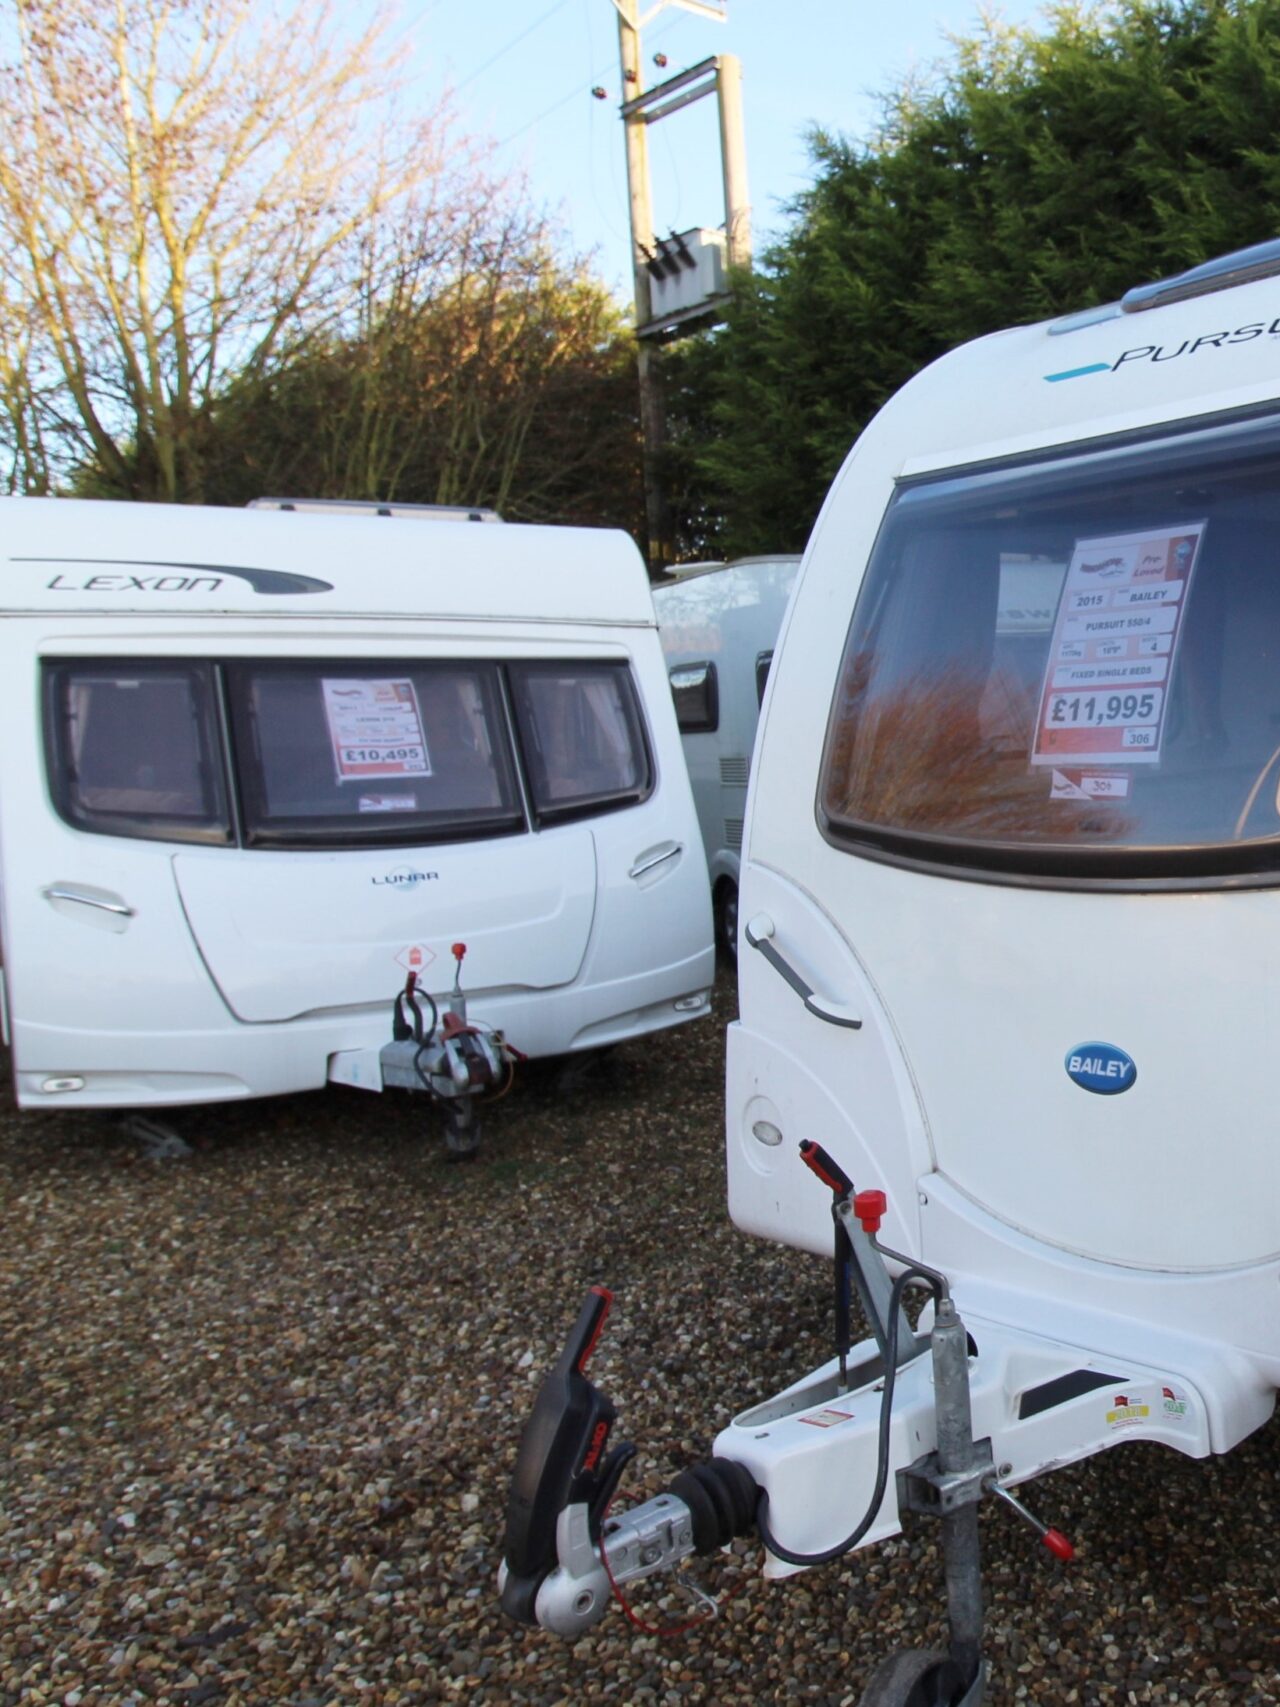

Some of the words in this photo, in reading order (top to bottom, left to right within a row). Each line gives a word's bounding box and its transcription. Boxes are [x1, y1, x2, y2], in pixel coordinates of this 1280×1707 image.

[46, 574, 224, 592] LEXON
[1077, 595, 1103, 606] 2015
[1129, 589, 1167, 602] BAILEY
[1086, 619, 1125, 631] PURSUIT
[1070, 670, 1095, 679] FIXED
[1096, 667, 1128, 678] SINGLE
[1129, 665, 1152, 675] BEDS
[1051, 694, 1154, 725] £11,995
[1129, 733, 1150, 744] 306
[346, 748, 419, 762] £10,495
[372, 871, 439, 885] LUNAR
[1068, 1056, 1131, 1078] BAILEY
